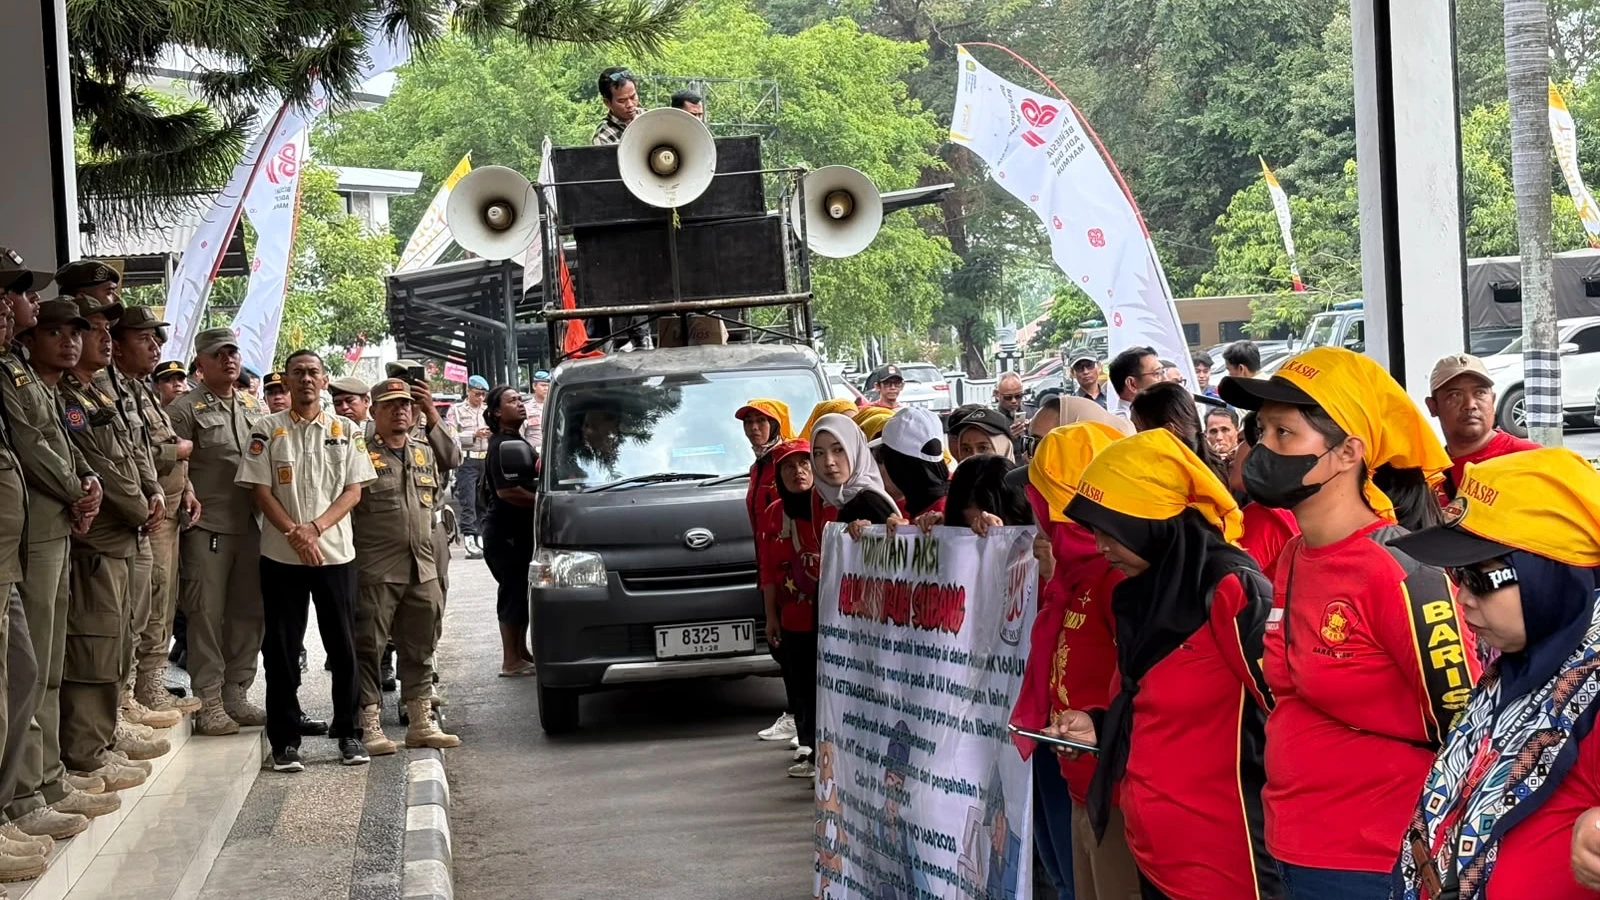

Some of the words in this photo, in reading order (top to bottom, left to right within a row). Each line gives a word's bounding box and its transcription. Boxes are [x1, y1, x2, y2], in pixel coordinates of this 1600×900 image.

[1285, 360, 1320, 380] KASBI
[1080, 481, 1104, 503] KASBI
[1465, 478, 1499, 506] KASBI
[659, 631, 668, 647] T
[682, 627, 720, 645] 8325
[732, 624, 750, 641] TV
[1532, 675, 1557, 707] KASBI
[1498, 704, 1533, 748] SUBANG
